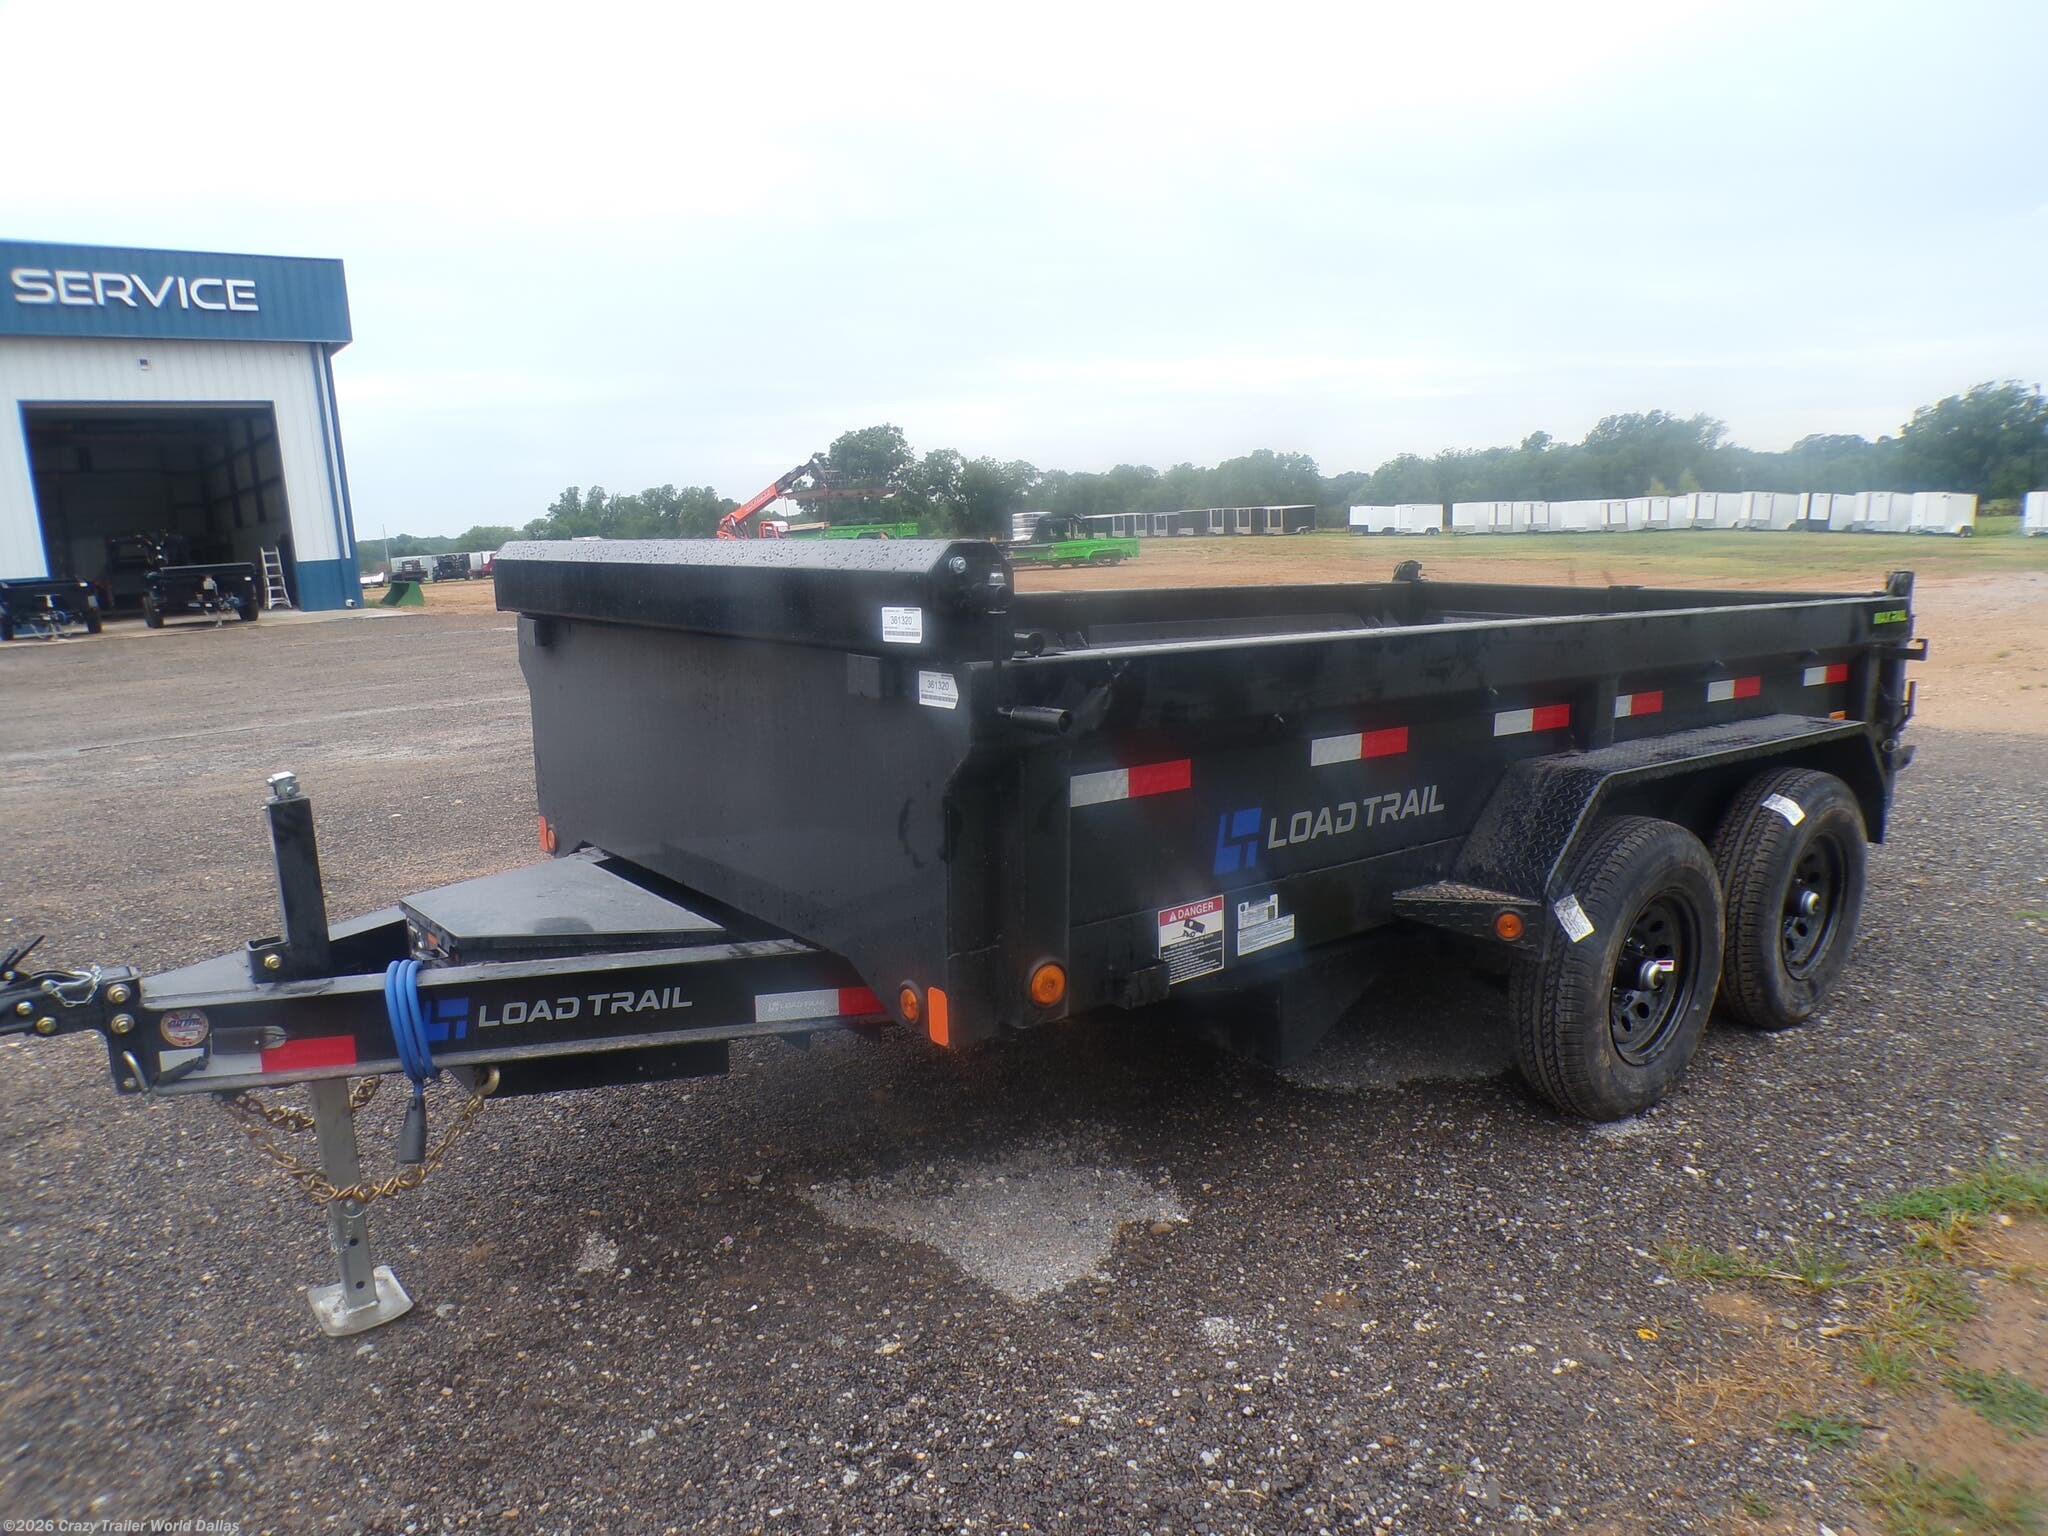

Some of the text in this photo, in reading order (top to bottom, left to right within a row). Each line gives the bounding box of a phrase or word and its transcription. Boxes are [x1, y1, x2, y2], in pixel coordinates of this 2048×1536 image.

[11, 268, 260, 311] SERVICE
[1267, 784, 1445, 850] LOAD TRAIL
[1177, 901, 1214, 919] DANGER
[478, 986, 693, 1028] LOAD TRAIL
